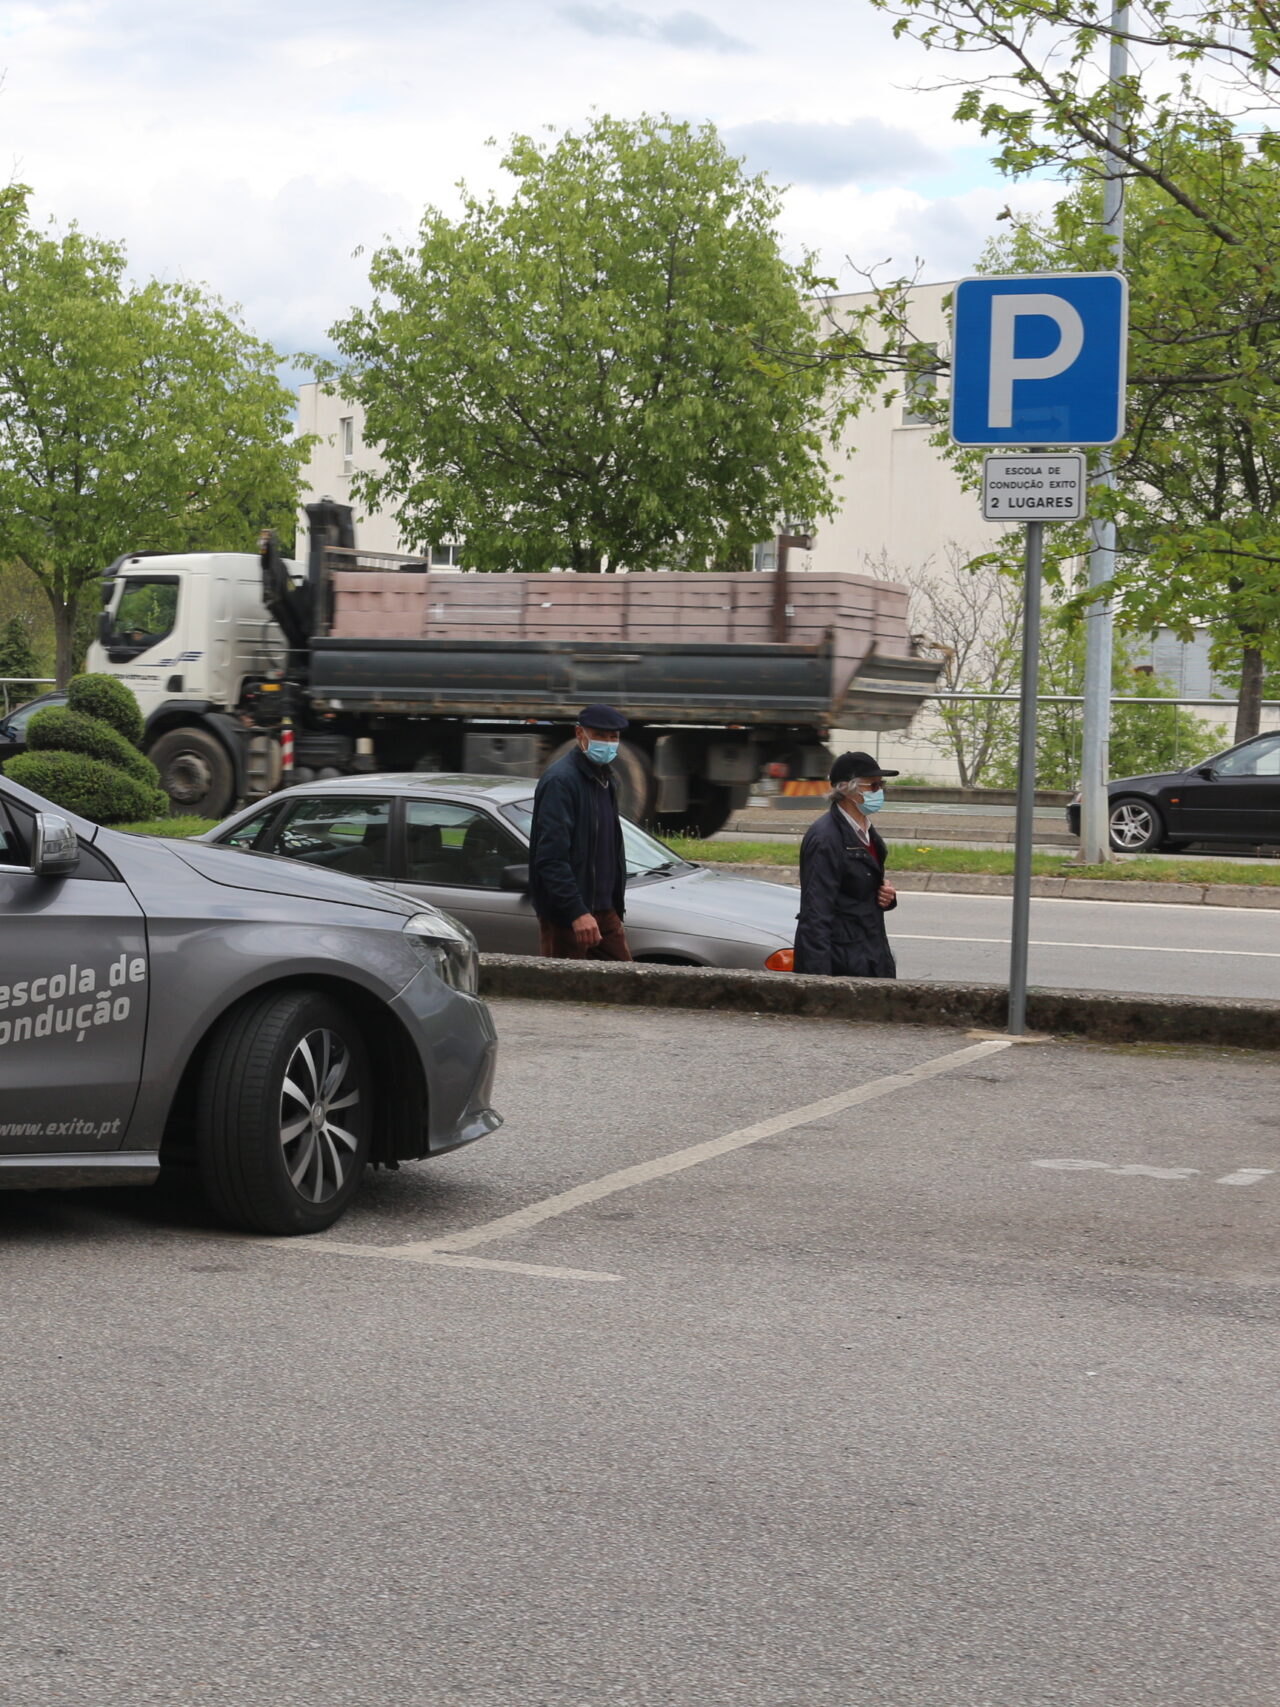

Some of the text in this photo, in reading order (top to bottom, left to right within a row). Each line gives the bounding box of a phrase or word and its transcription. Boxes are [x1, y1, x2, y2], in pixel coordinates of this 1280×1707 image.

[988, 293, 1084, 428] P
[1005, 467, 1061, 475] ESCOLA DE
[989, 480, 1076, 490] CONDUÇÃO EXITO
[991, 497, 1073, 508] 2 LUGARES
[109, 954, 146, 987] de
